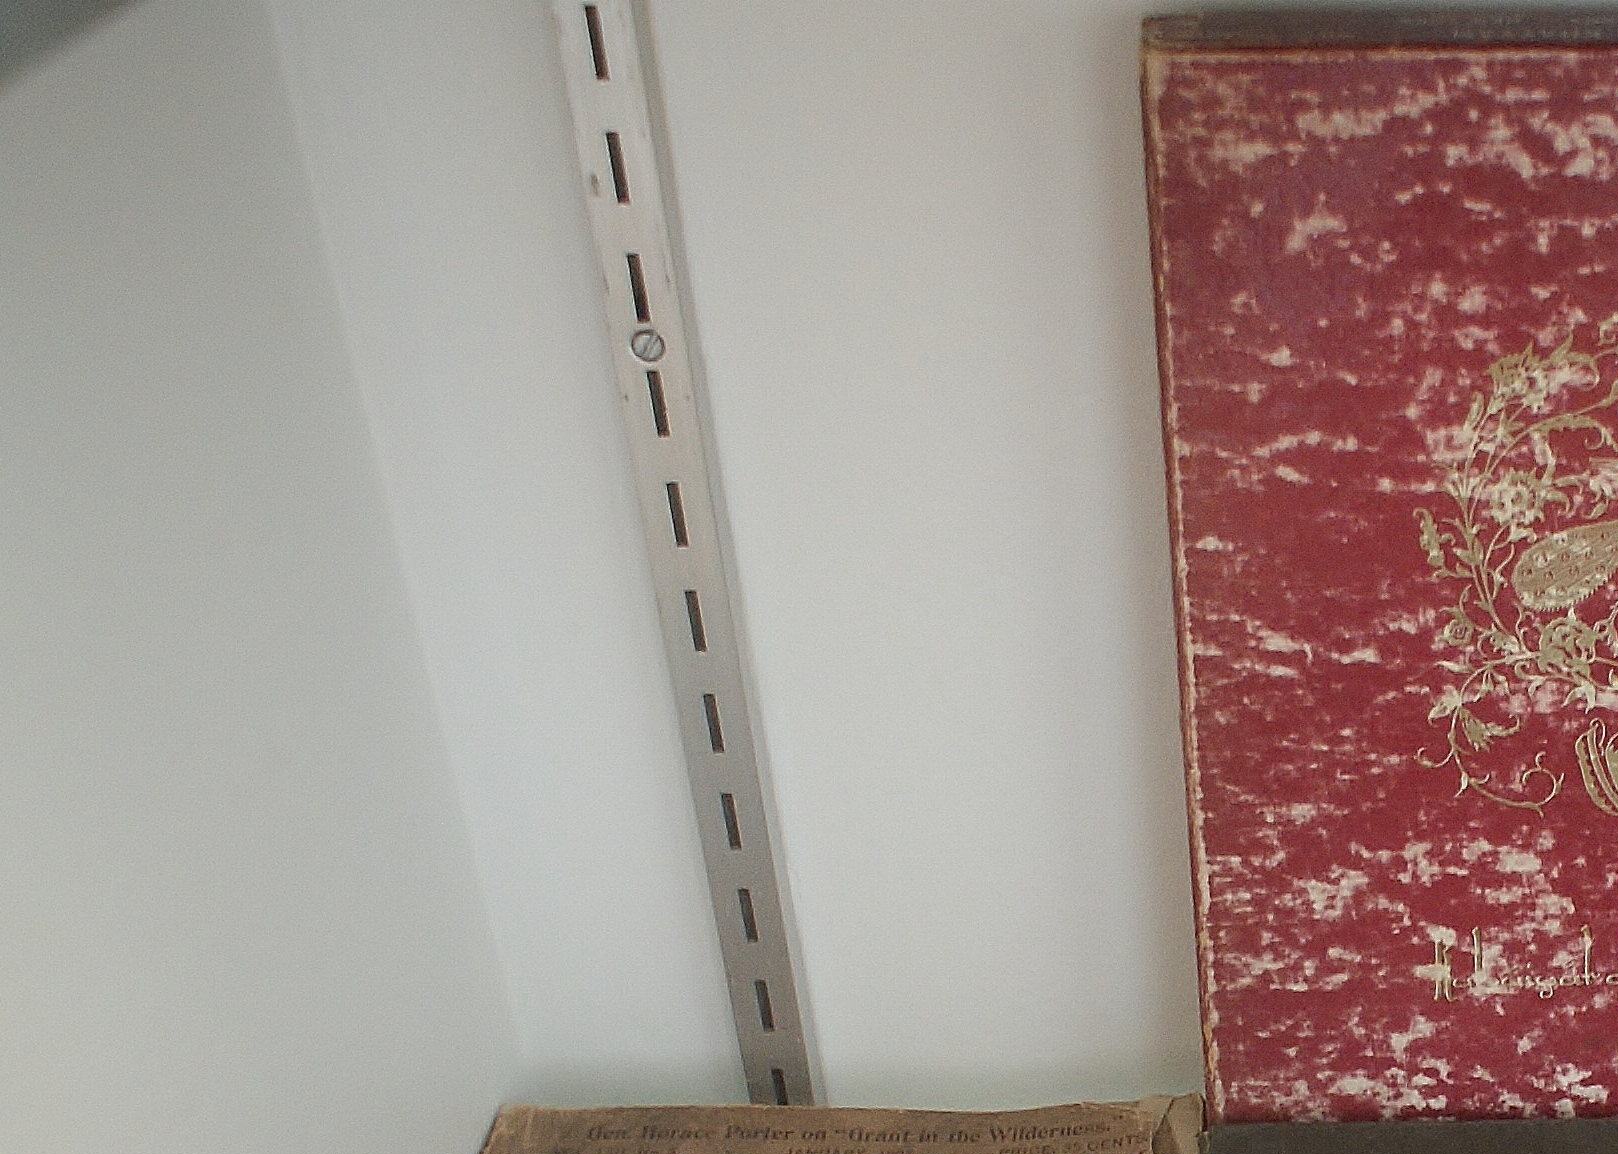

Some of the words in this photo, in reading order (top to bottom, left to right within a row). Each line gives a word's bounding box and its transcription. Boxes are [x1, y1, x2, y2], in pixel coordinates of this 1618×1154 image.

[802, 1128, 827, 1141] on
[918, 1128, 938, 1143] in
[948, 1129, 980, 1143] the
